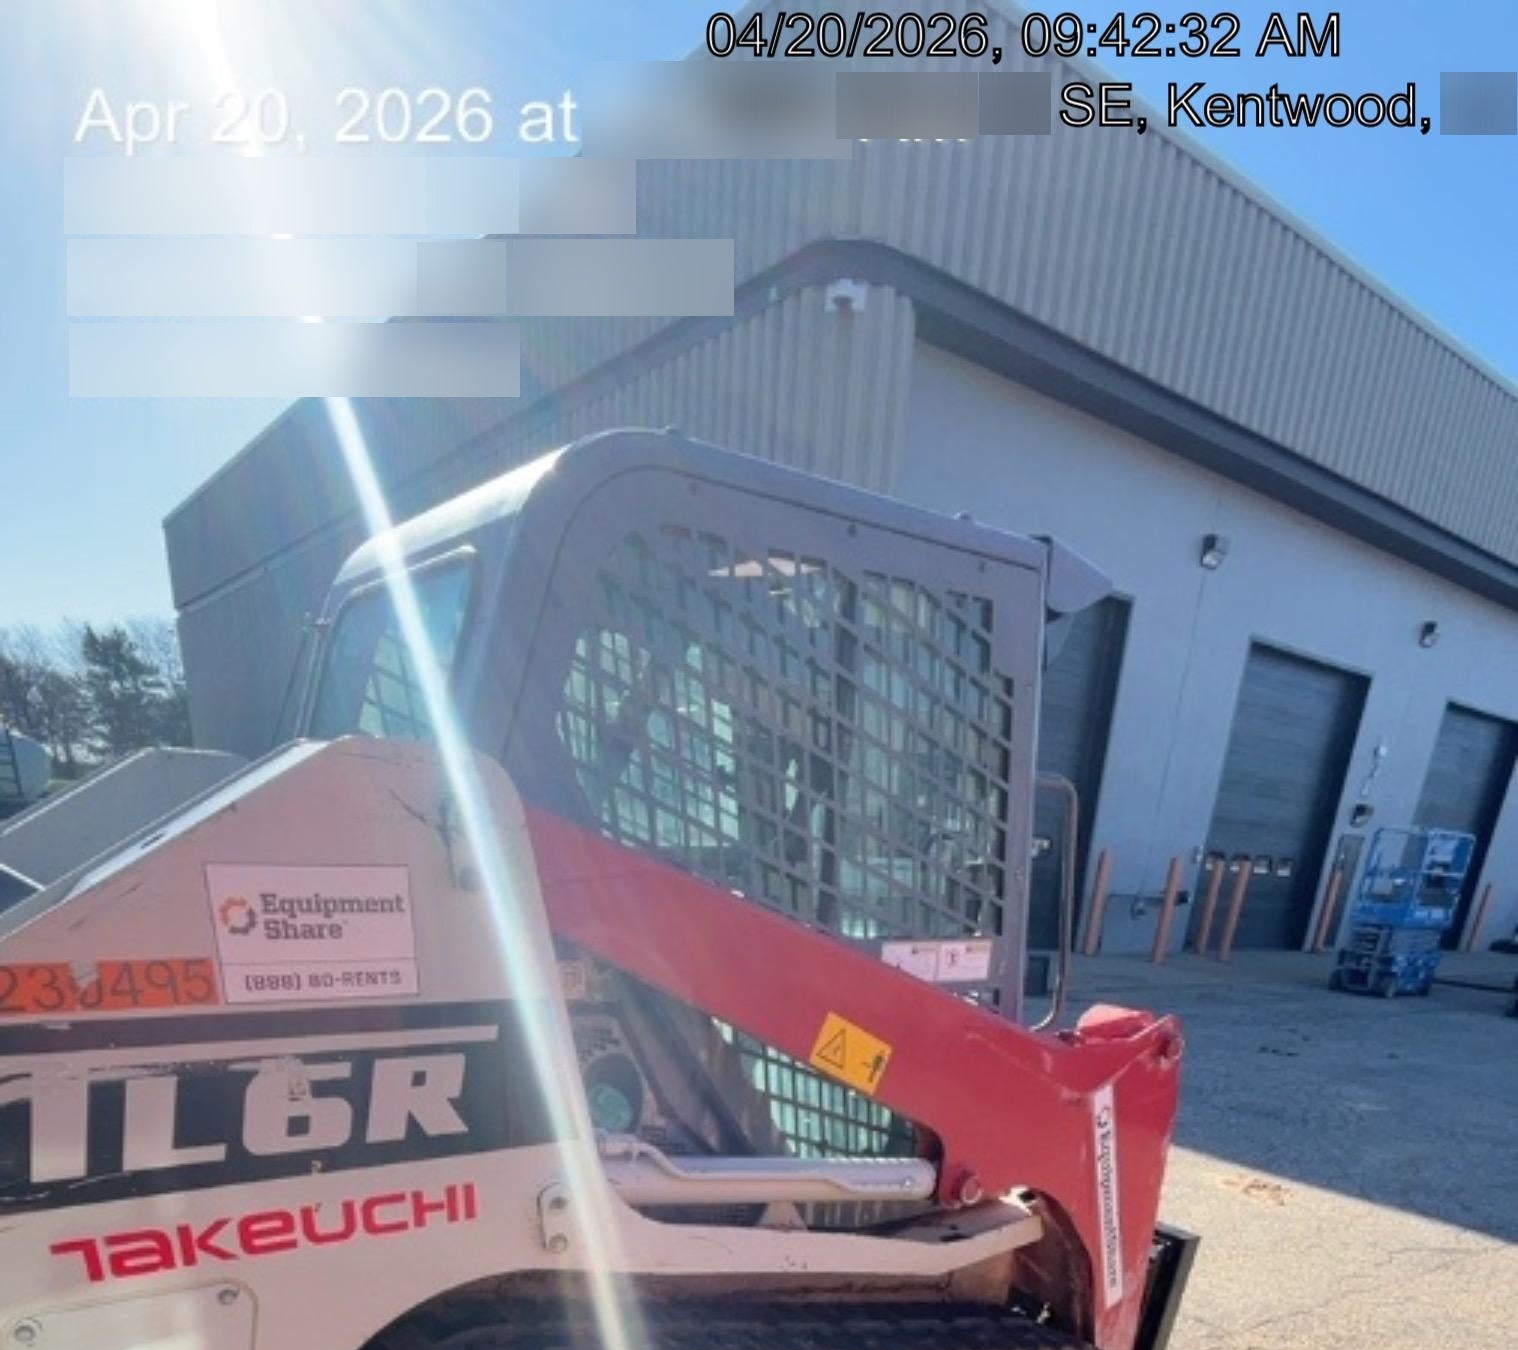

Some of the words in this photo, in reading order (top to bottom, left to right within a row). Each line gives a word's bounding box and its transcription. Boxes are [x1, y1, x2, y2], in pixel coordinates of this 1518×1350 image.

[259, 893, 406, 919] Equipment
[263, 919, 344, 940] Share
[245, 973, 302, 991] (888)
[0, 1053, 469, 1183] TL6R
